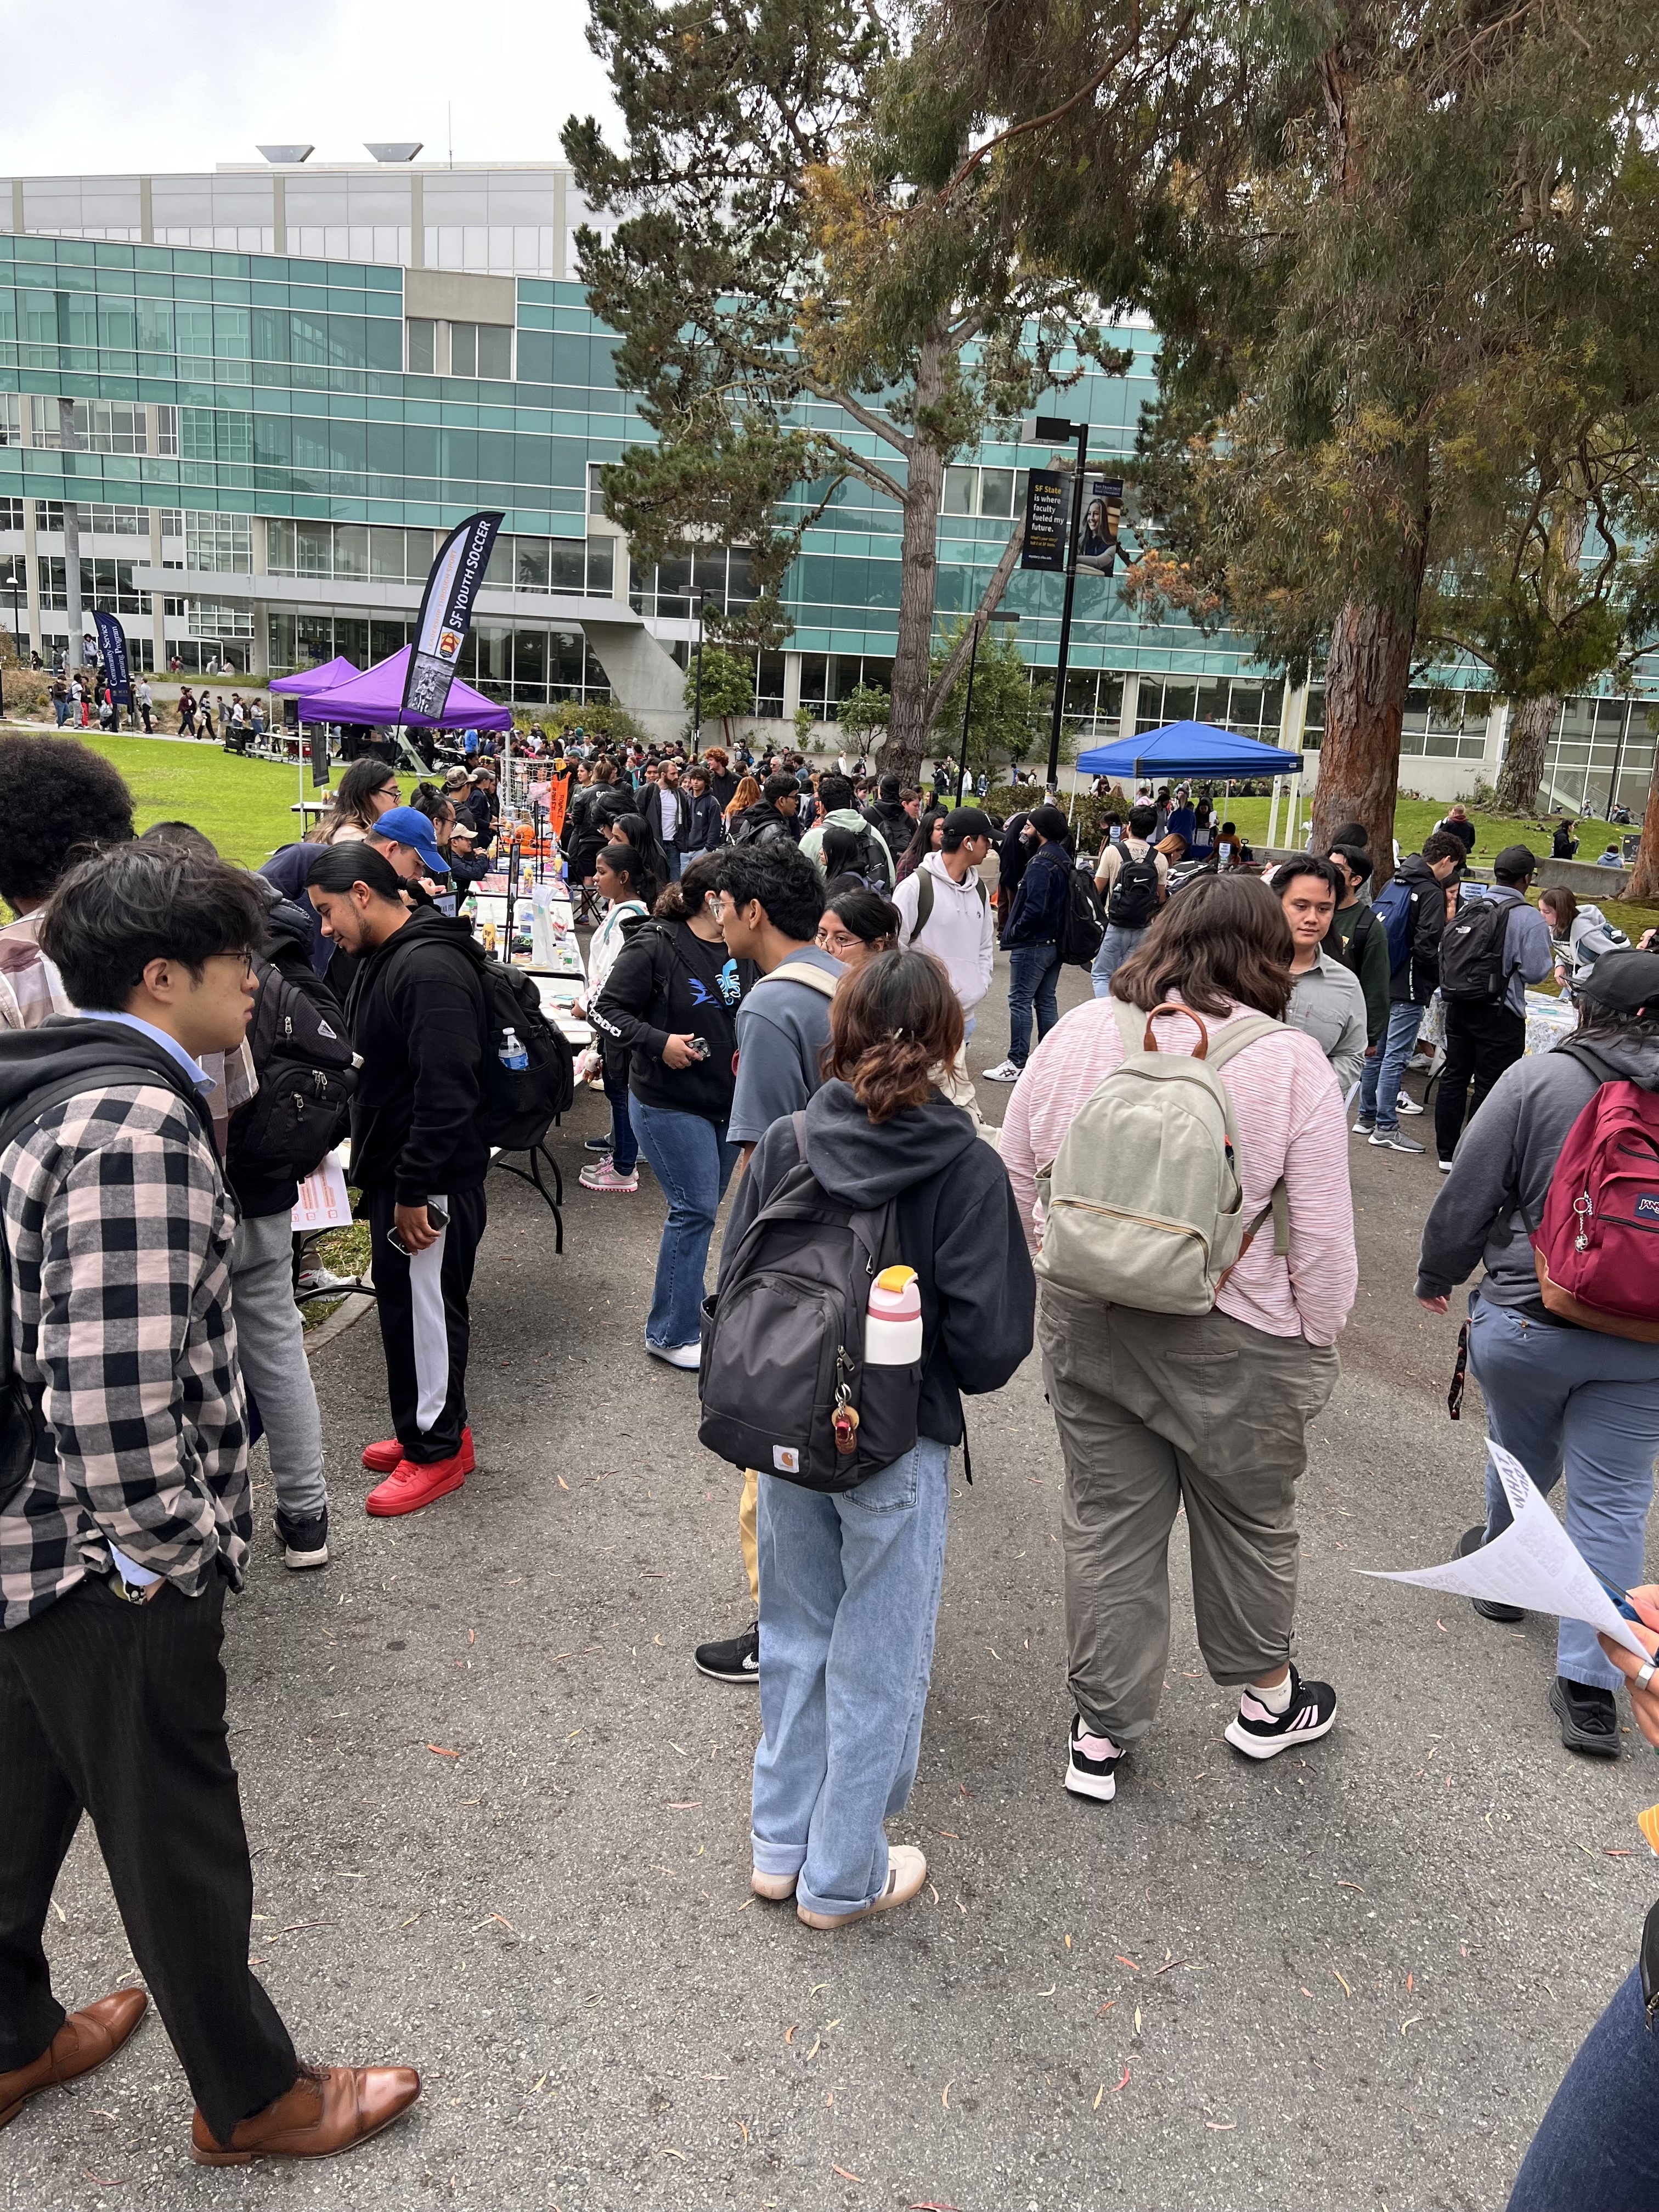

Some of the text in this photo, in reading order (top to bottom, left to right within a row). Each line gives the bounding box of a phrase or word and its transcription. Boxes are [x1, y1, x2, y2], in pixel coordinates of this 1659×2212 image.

[1041, 495, 1061, 504] where
[1044, 486, 1062, 494] State
[1032, 513, 1053, 522] fueled
[1033, 504, 1056, 514] faculty
[1032, 523, 1054, 532] future.
[449, 520, 491, 628] SF YOUTH SOCCER
[428, 549, 457, 650] LEADERSHIP THROUGH SPORT
[101, 624, 117, 686] Community Service
[112, 626, 127, 683] Learning Program
[1496, 1452, 1525, 1508] WHAT
